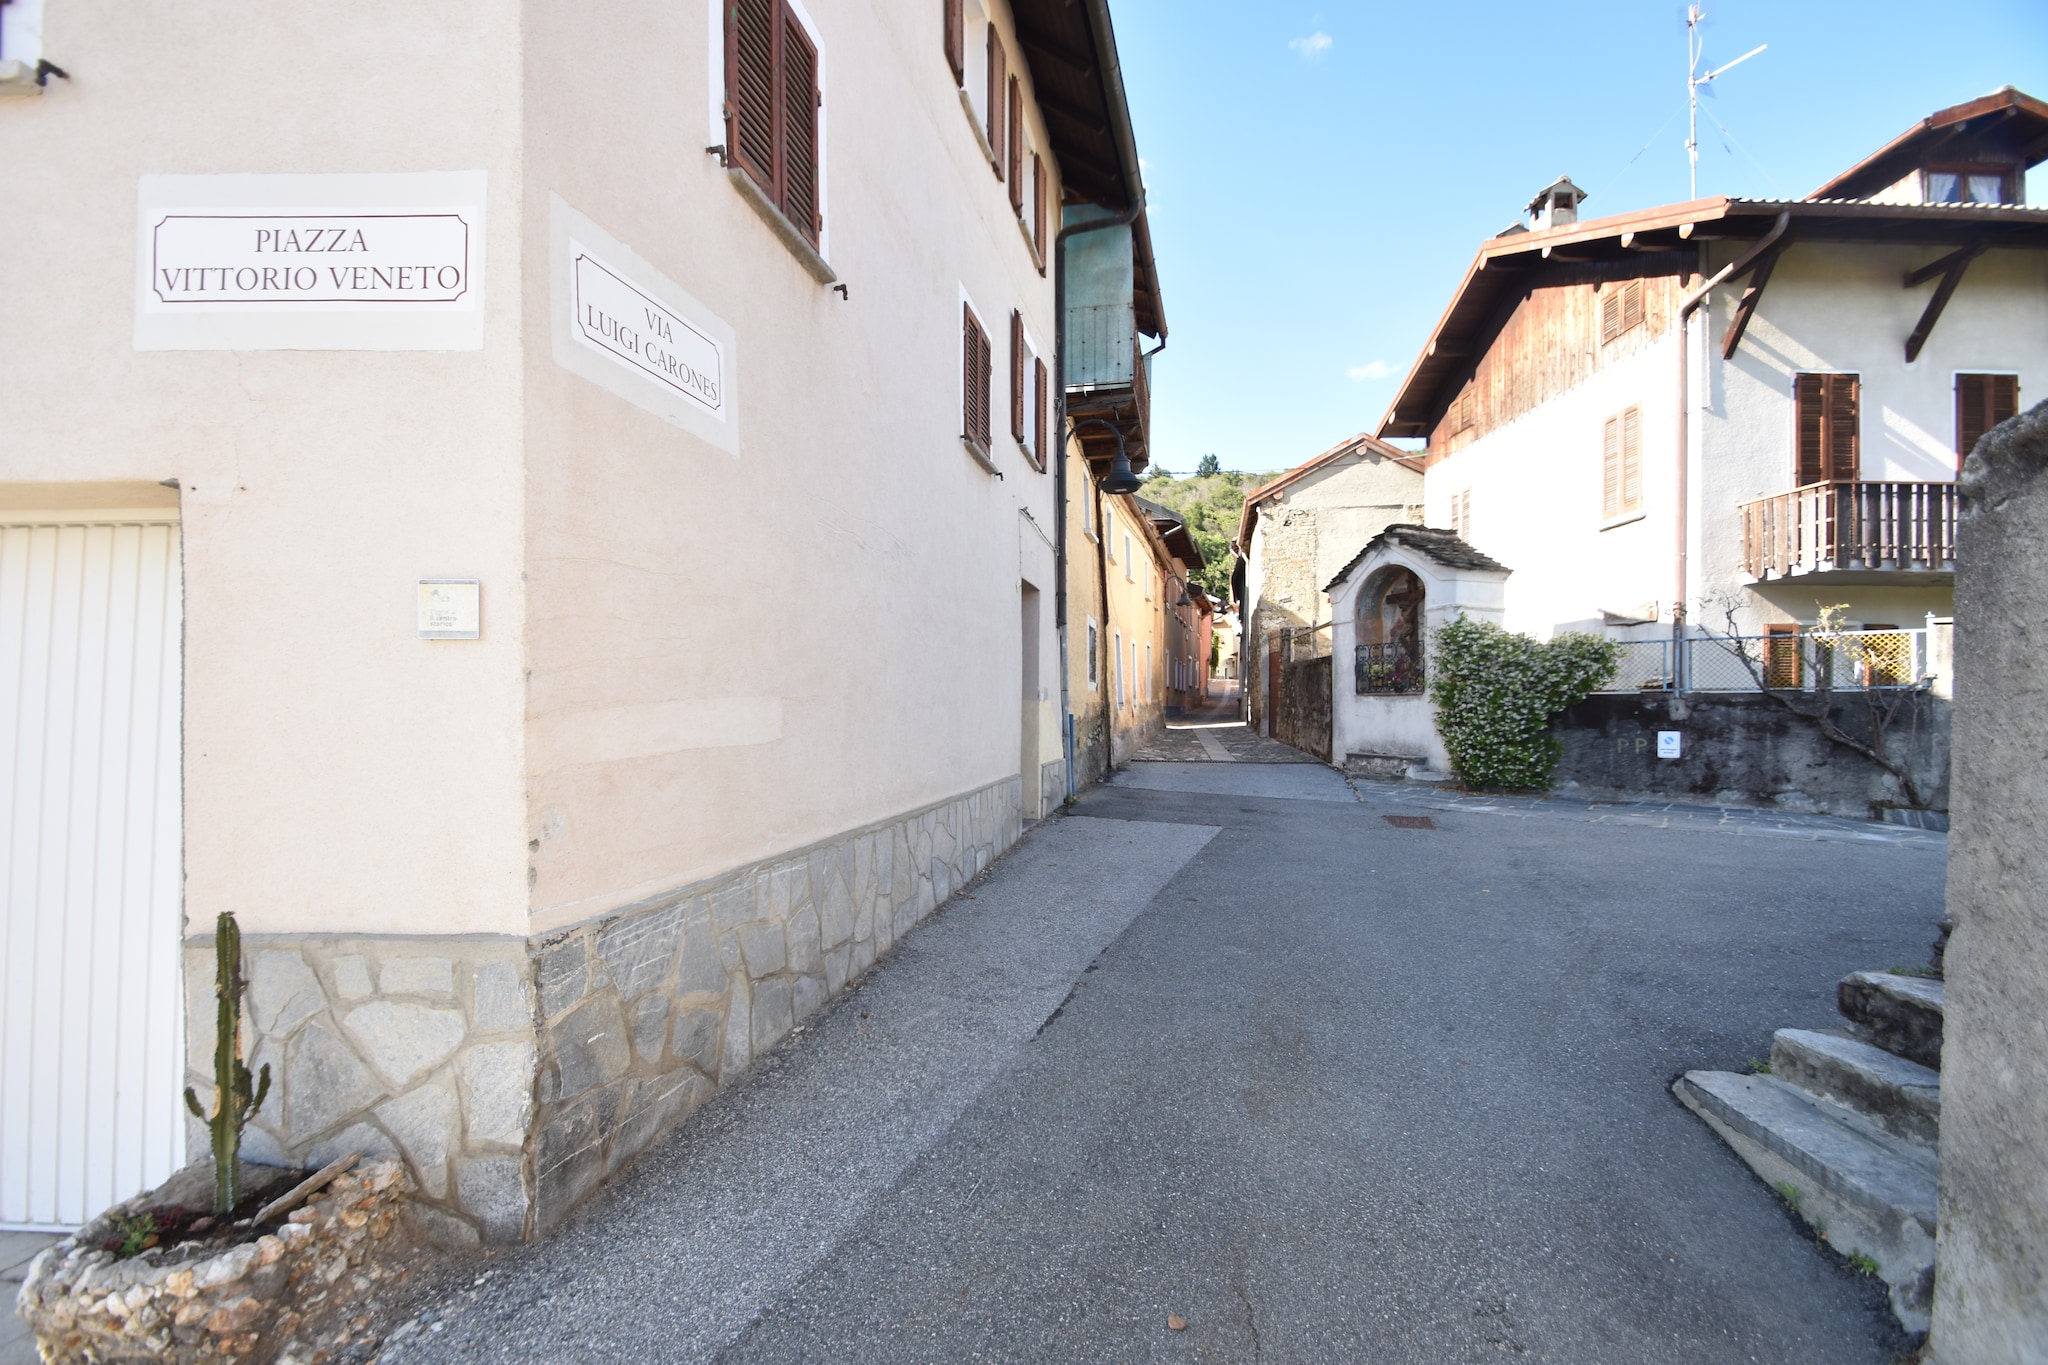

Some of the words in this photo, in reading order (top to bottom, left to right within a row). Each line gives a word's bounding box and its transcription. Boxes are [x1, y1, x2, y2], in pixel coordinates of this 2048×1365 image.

[255, 229, 368, 253] PIAZZA
[161, 267, 317, 291] VITTORIO
[328, 265, 460, 290] VENETO
[644, 307, 673, 344] VIA
[587, 304, 640, 354] LUIGI
[645, 341, 717, 401] CARONES
